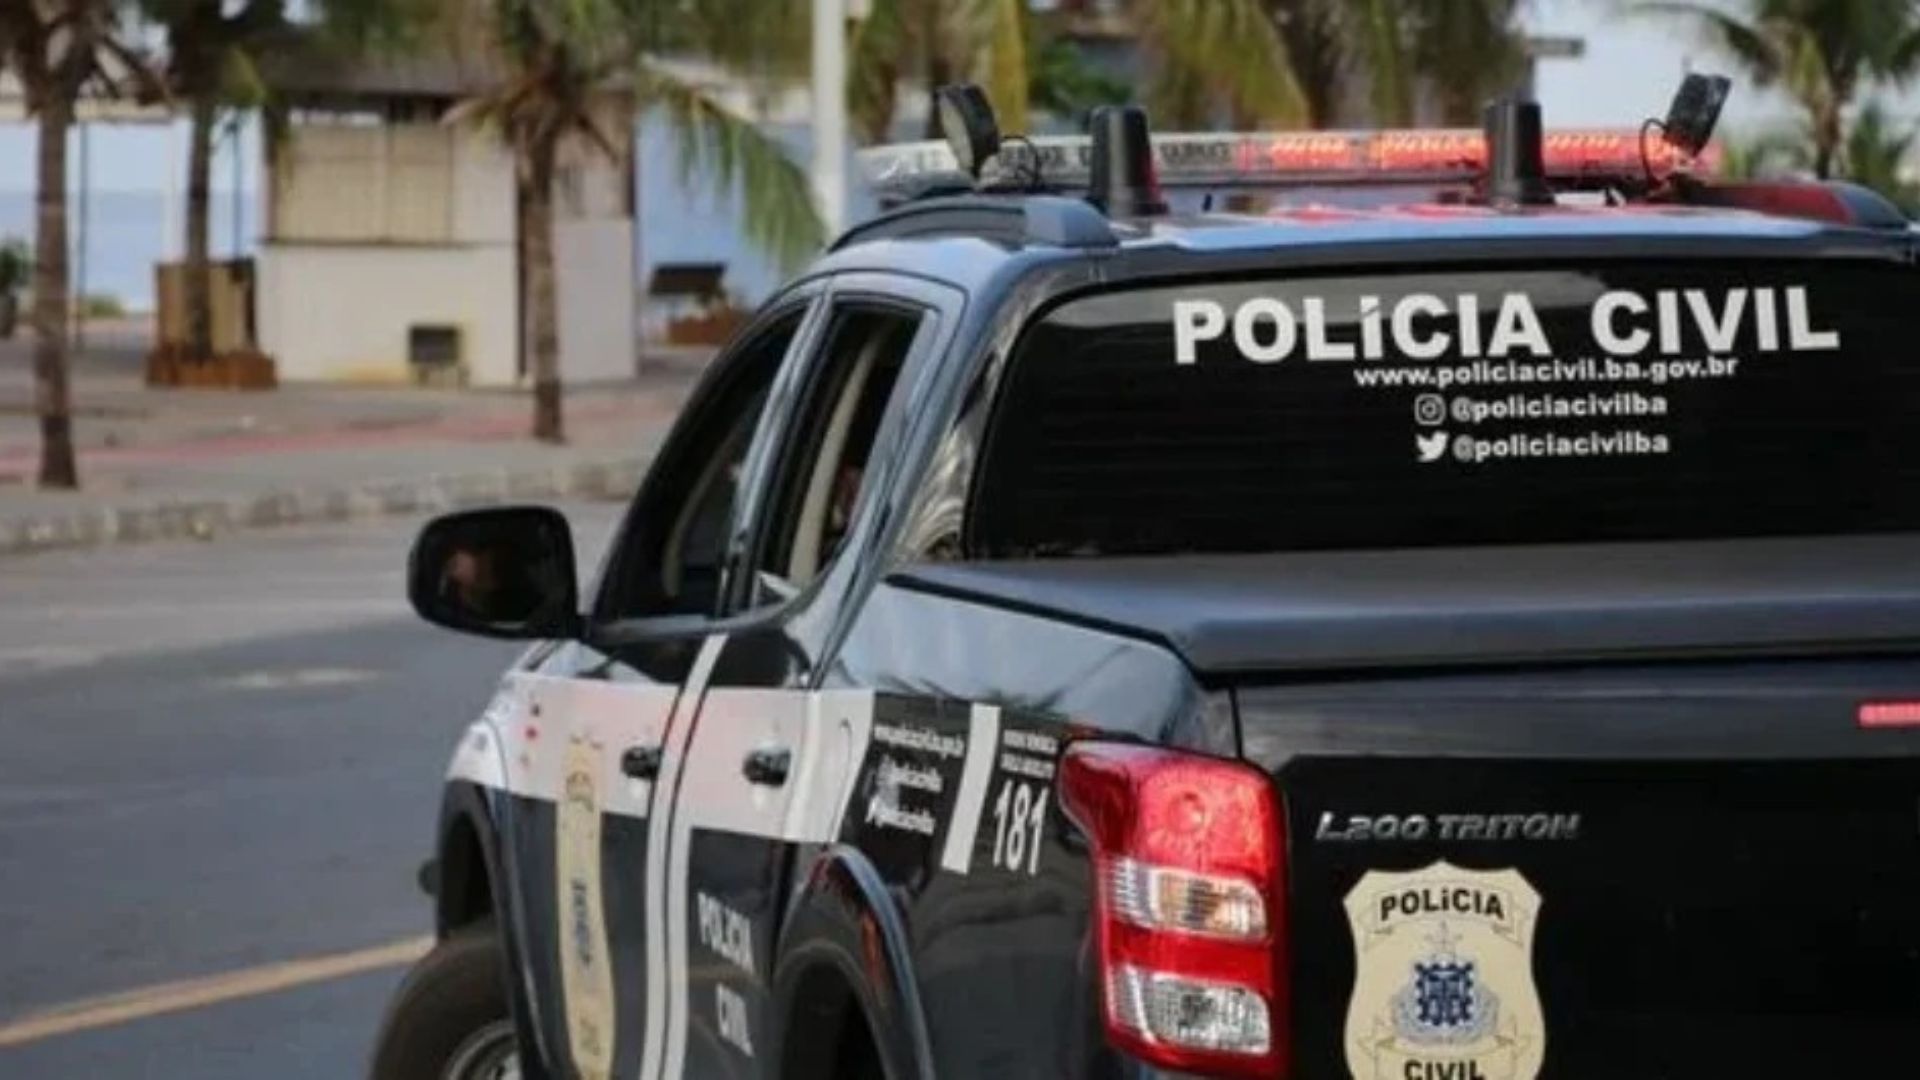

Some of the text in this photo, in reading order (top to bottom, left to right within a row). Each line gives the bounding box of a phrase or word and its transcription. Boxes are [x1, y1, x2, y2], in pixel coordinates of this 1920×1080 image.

[1591, 286, 1840, 355] CIVIL
[1353, 355, 1738, 388] www.policiacivil.ba.gov.br
[1451, 392, 1669, 424] @policiacivilba
[1452, 430, 1670, 463] @policiacivilba
[994, 779, 1049, 876] 181
[1315, 811, 1580, 841] L200 TRITON
[1403, 1059, 1486, 1080] CIVIL
